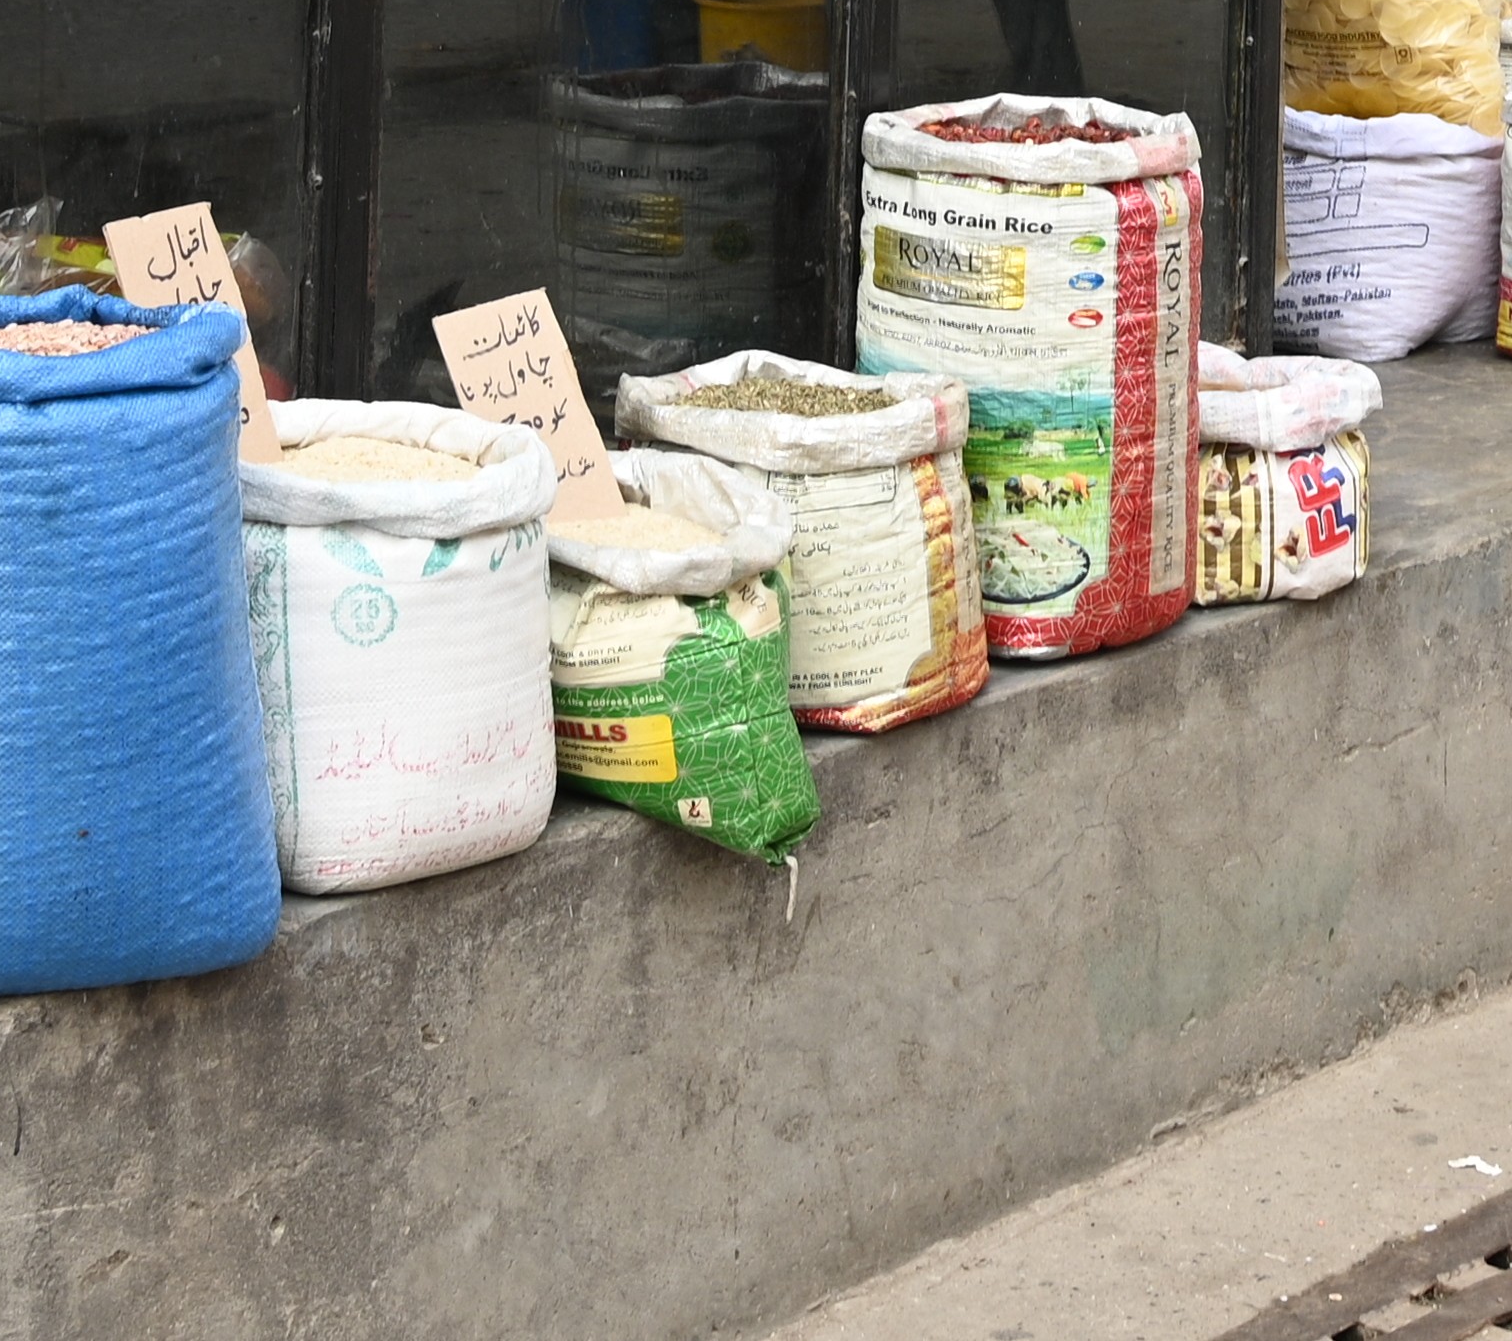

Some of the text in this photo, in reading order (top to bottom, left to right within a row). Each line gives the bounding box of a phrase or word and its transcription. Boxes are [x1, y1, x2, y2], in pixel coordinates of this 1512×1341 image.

[866, 190, 1054, 236] Extra Long Grain Rice
[899, 237, 981, 274] ROYAL
[1163, 239, 1183, 368] ROYAL
[985, 321, 1037, 335] Aromatic
